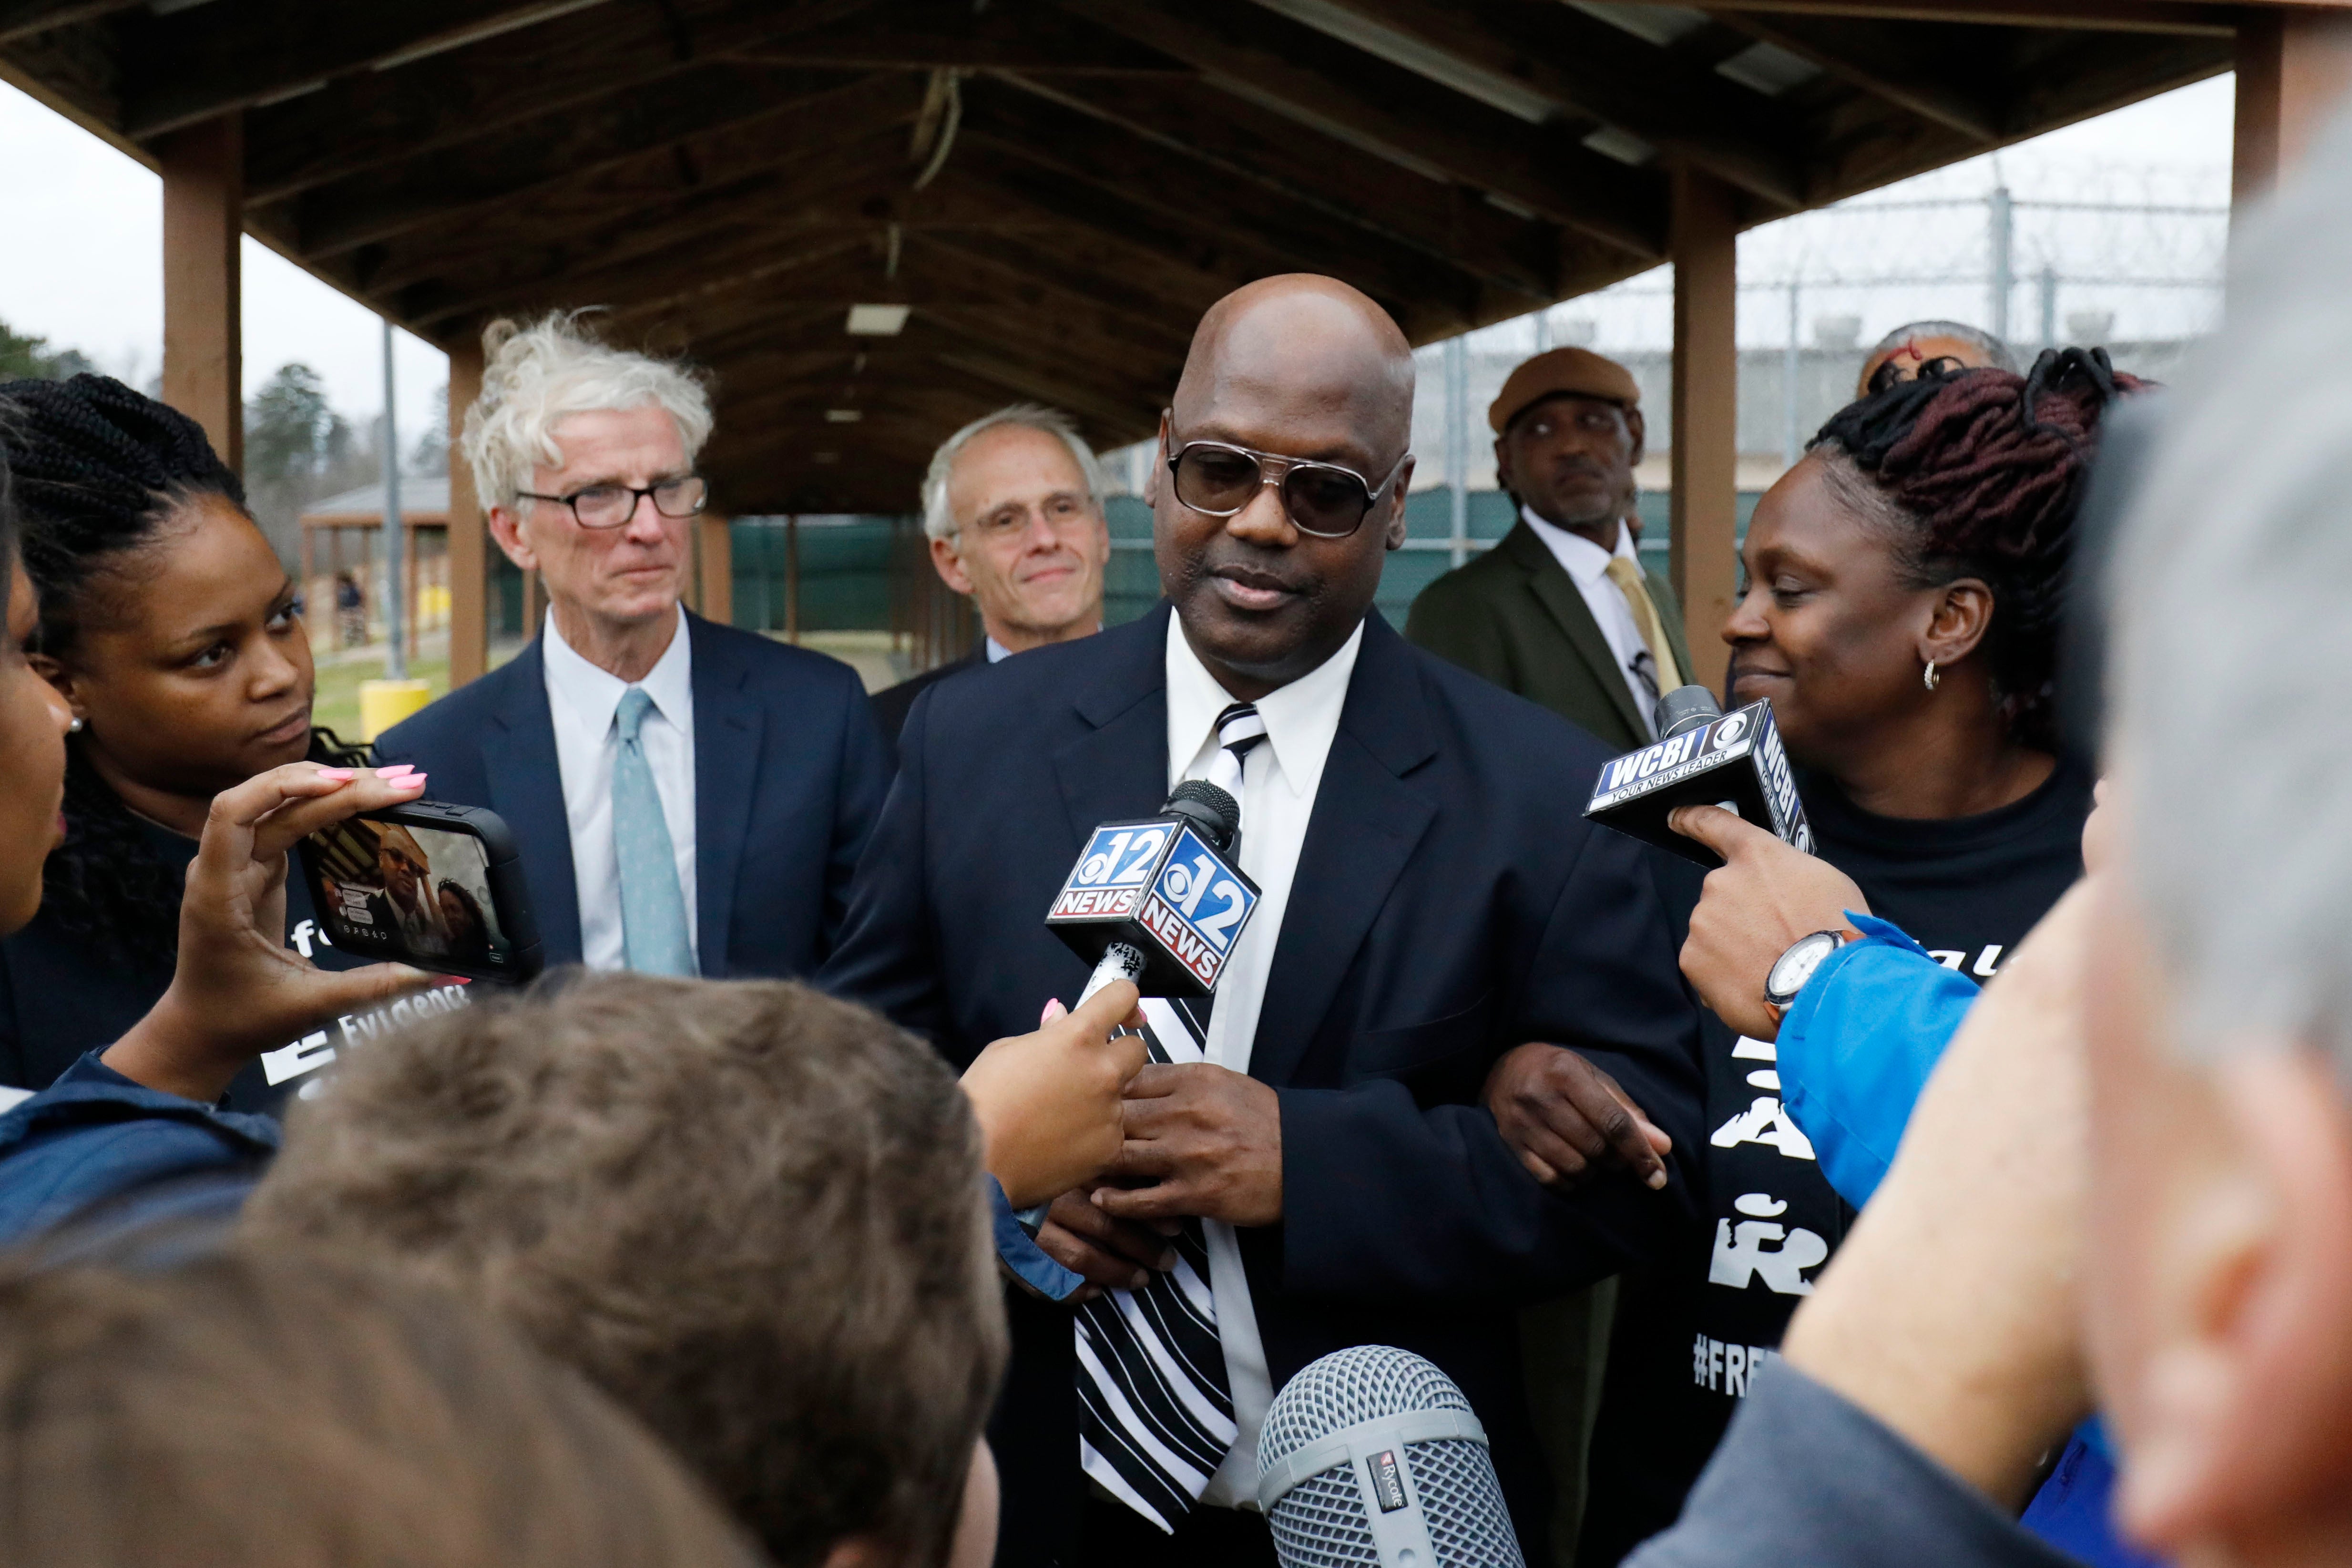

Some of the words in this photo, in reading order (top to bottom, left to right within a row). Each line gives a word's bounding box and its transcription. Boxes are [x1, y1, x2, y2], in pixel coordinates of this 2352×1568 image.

[1609, 730, 1698, 790] WCBI
[1612, 782, 1645, 802] YOUR
[1646, 768, 1680, 790] NEWS
[1682, 750, 1727, 776] LEADER
[1763, 719, 1796, 825] WCBI
[1095, 829, 1165, 884] 12
[1056, 890, 1136, 914] NEWS
[1179, 854, 1246, 952] 12
[1143, 899, 1217, 979] NEWS
[1382, 1464, 1402, 1507] Rycote
